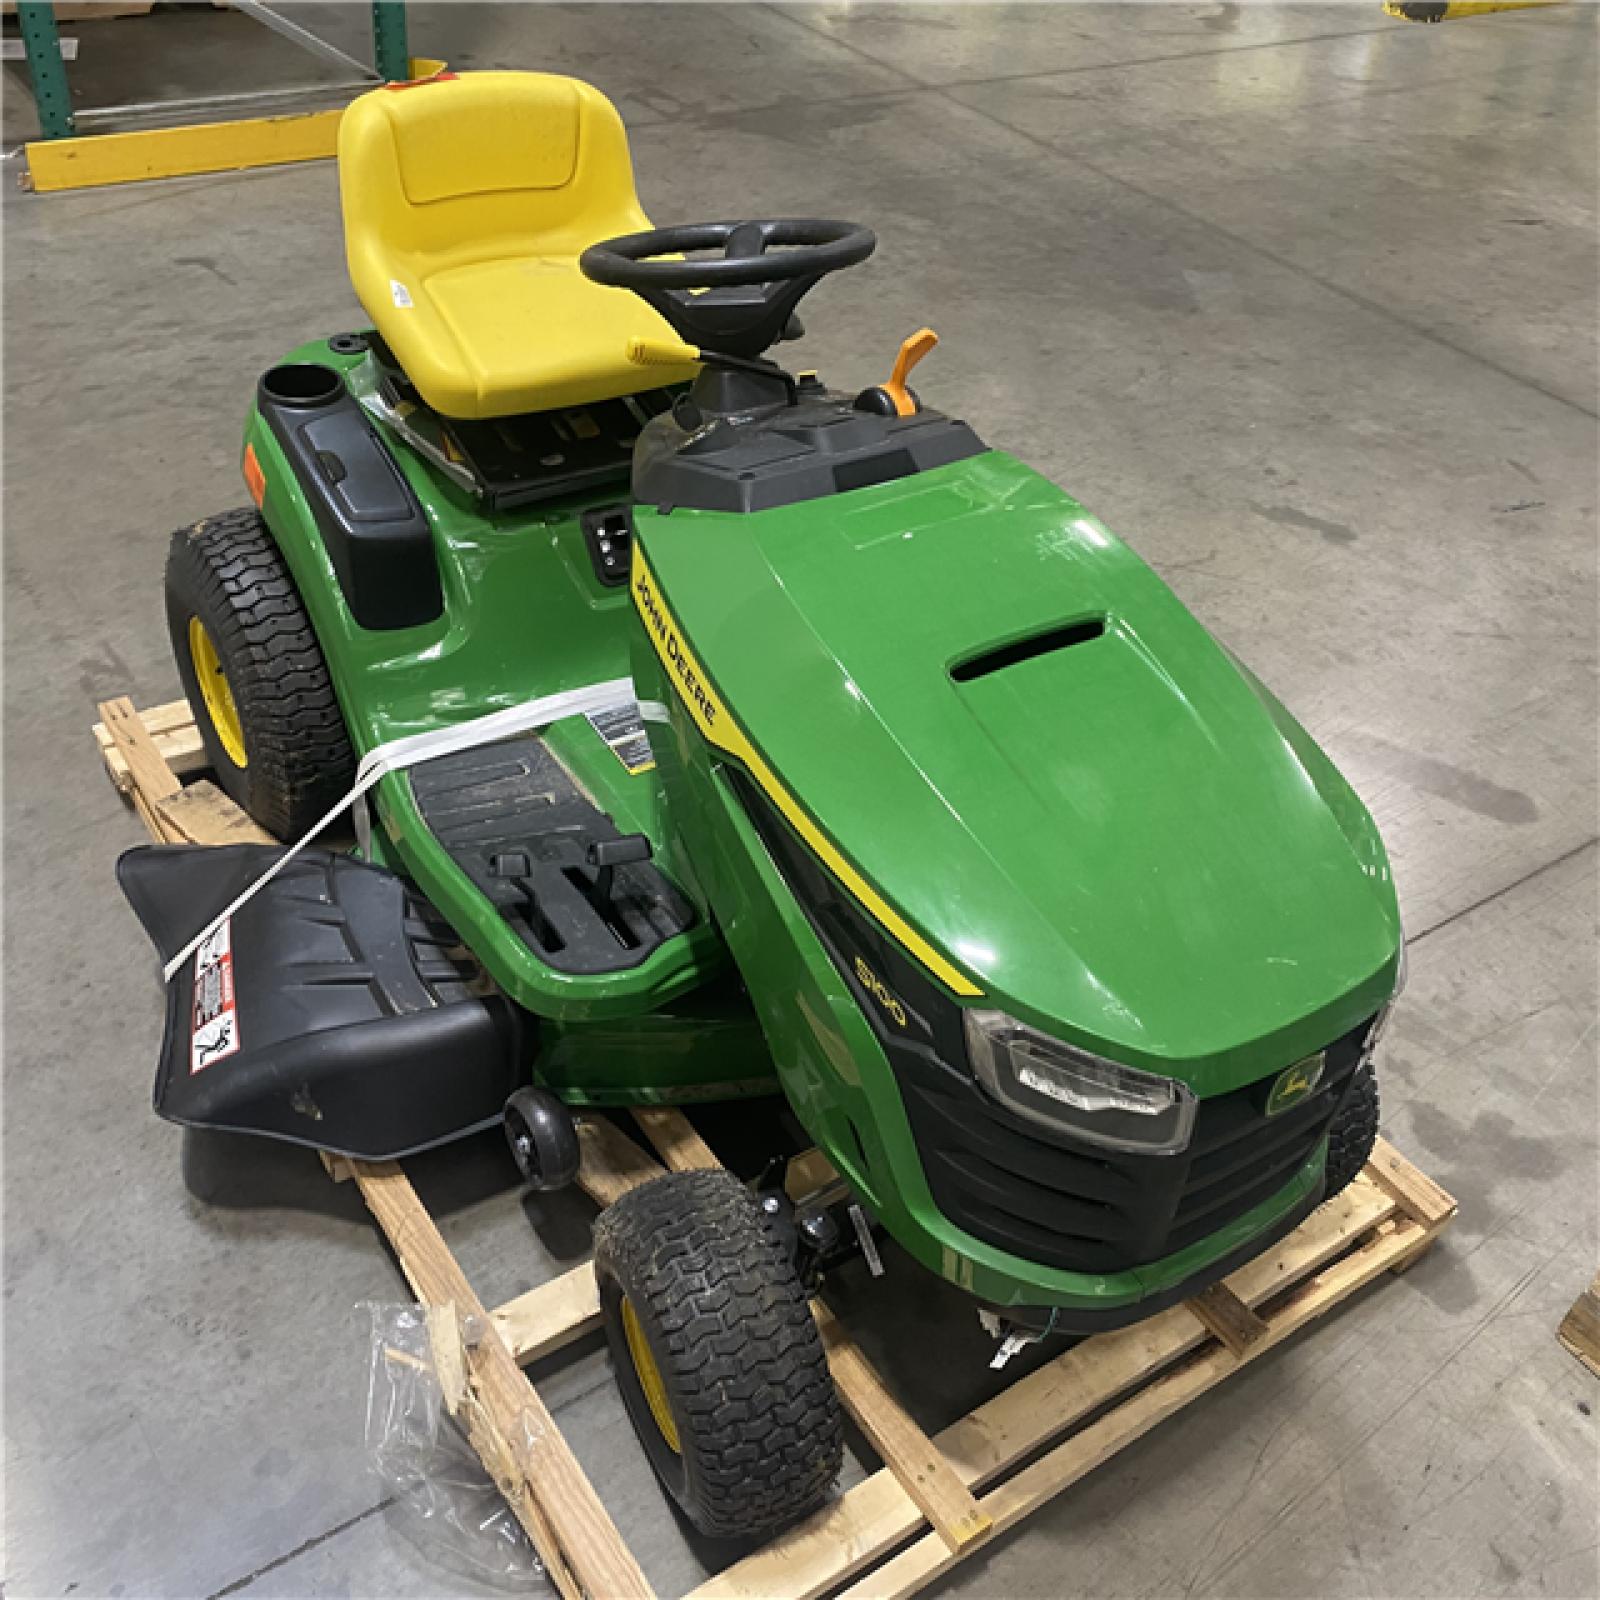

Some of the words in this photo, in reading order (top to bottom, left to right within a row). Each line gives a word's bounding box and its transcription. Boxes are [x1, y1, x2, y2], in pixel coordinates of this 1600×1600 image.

[637, 574, 667, 641] JOHN
[666, 632, 715, 726] DEERE
[854, 956, 906, 1026] S100
